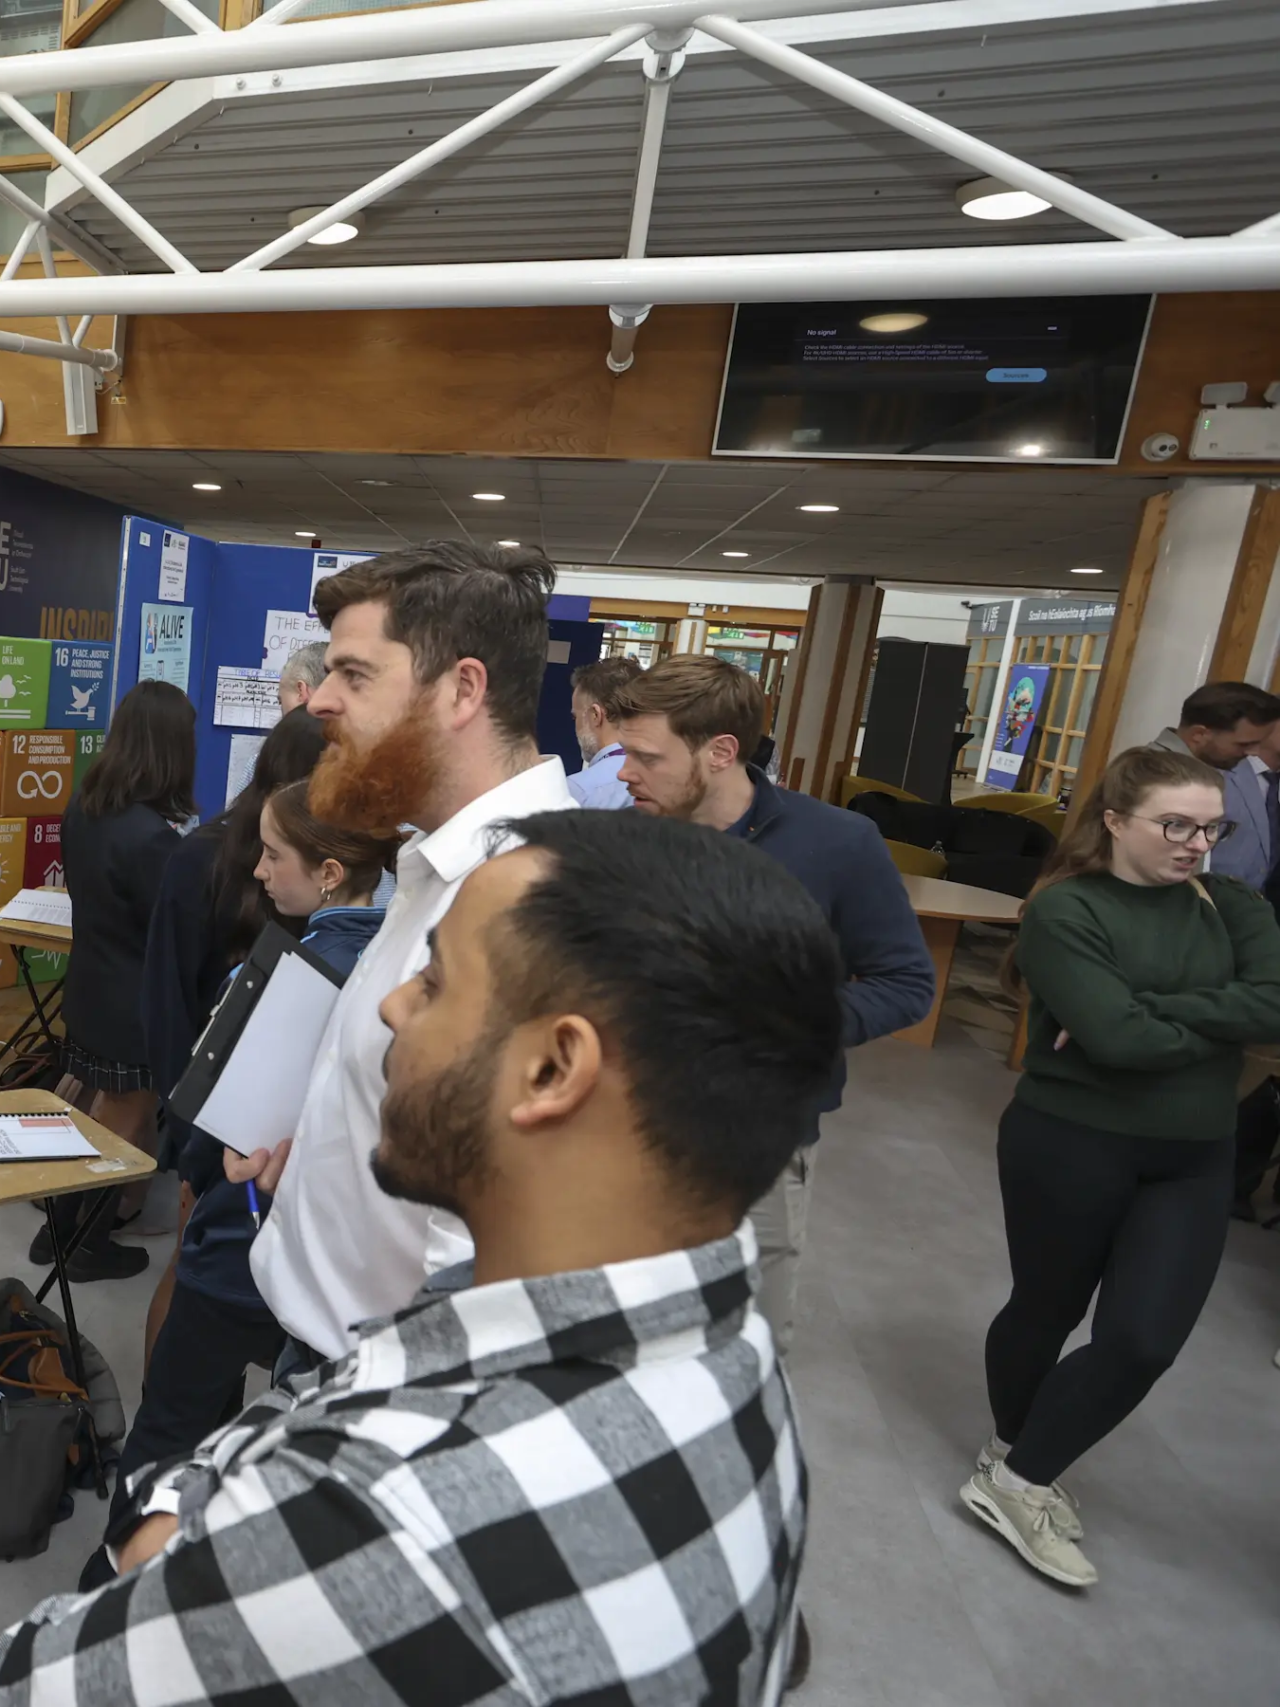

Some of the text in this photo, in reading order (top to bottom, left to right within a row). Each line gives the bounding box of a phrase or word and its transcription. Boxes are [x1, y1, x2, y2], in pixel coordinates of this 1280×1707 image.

[159, 614, 185, 639] ALIVE
[275, 615, 300, 631] THE
[269, 635, 287, 650] OF
[3, 646, 13, 654] LIFE
[72, 649, 109, 659] PEACE, JUSTICE
[2, 656, 24, 665] ON LAND
[55, 648, 69, 666] 16
[71, 659, 101, 668] AND STRONG
[71, 669, 103, 679] INSTITUTIONS
[12, 735, 26, 754] 12
[29, 735, 63, 744] RESPONSIBLE
[28, 745, 65, 754] CONSUMPTION
[81, 736, 93, 754] 13
[28, 756, 71, 764] AND PRODUCTION
[10, 824, 21, 832] AND
[34, 825, 43, 843] 8
